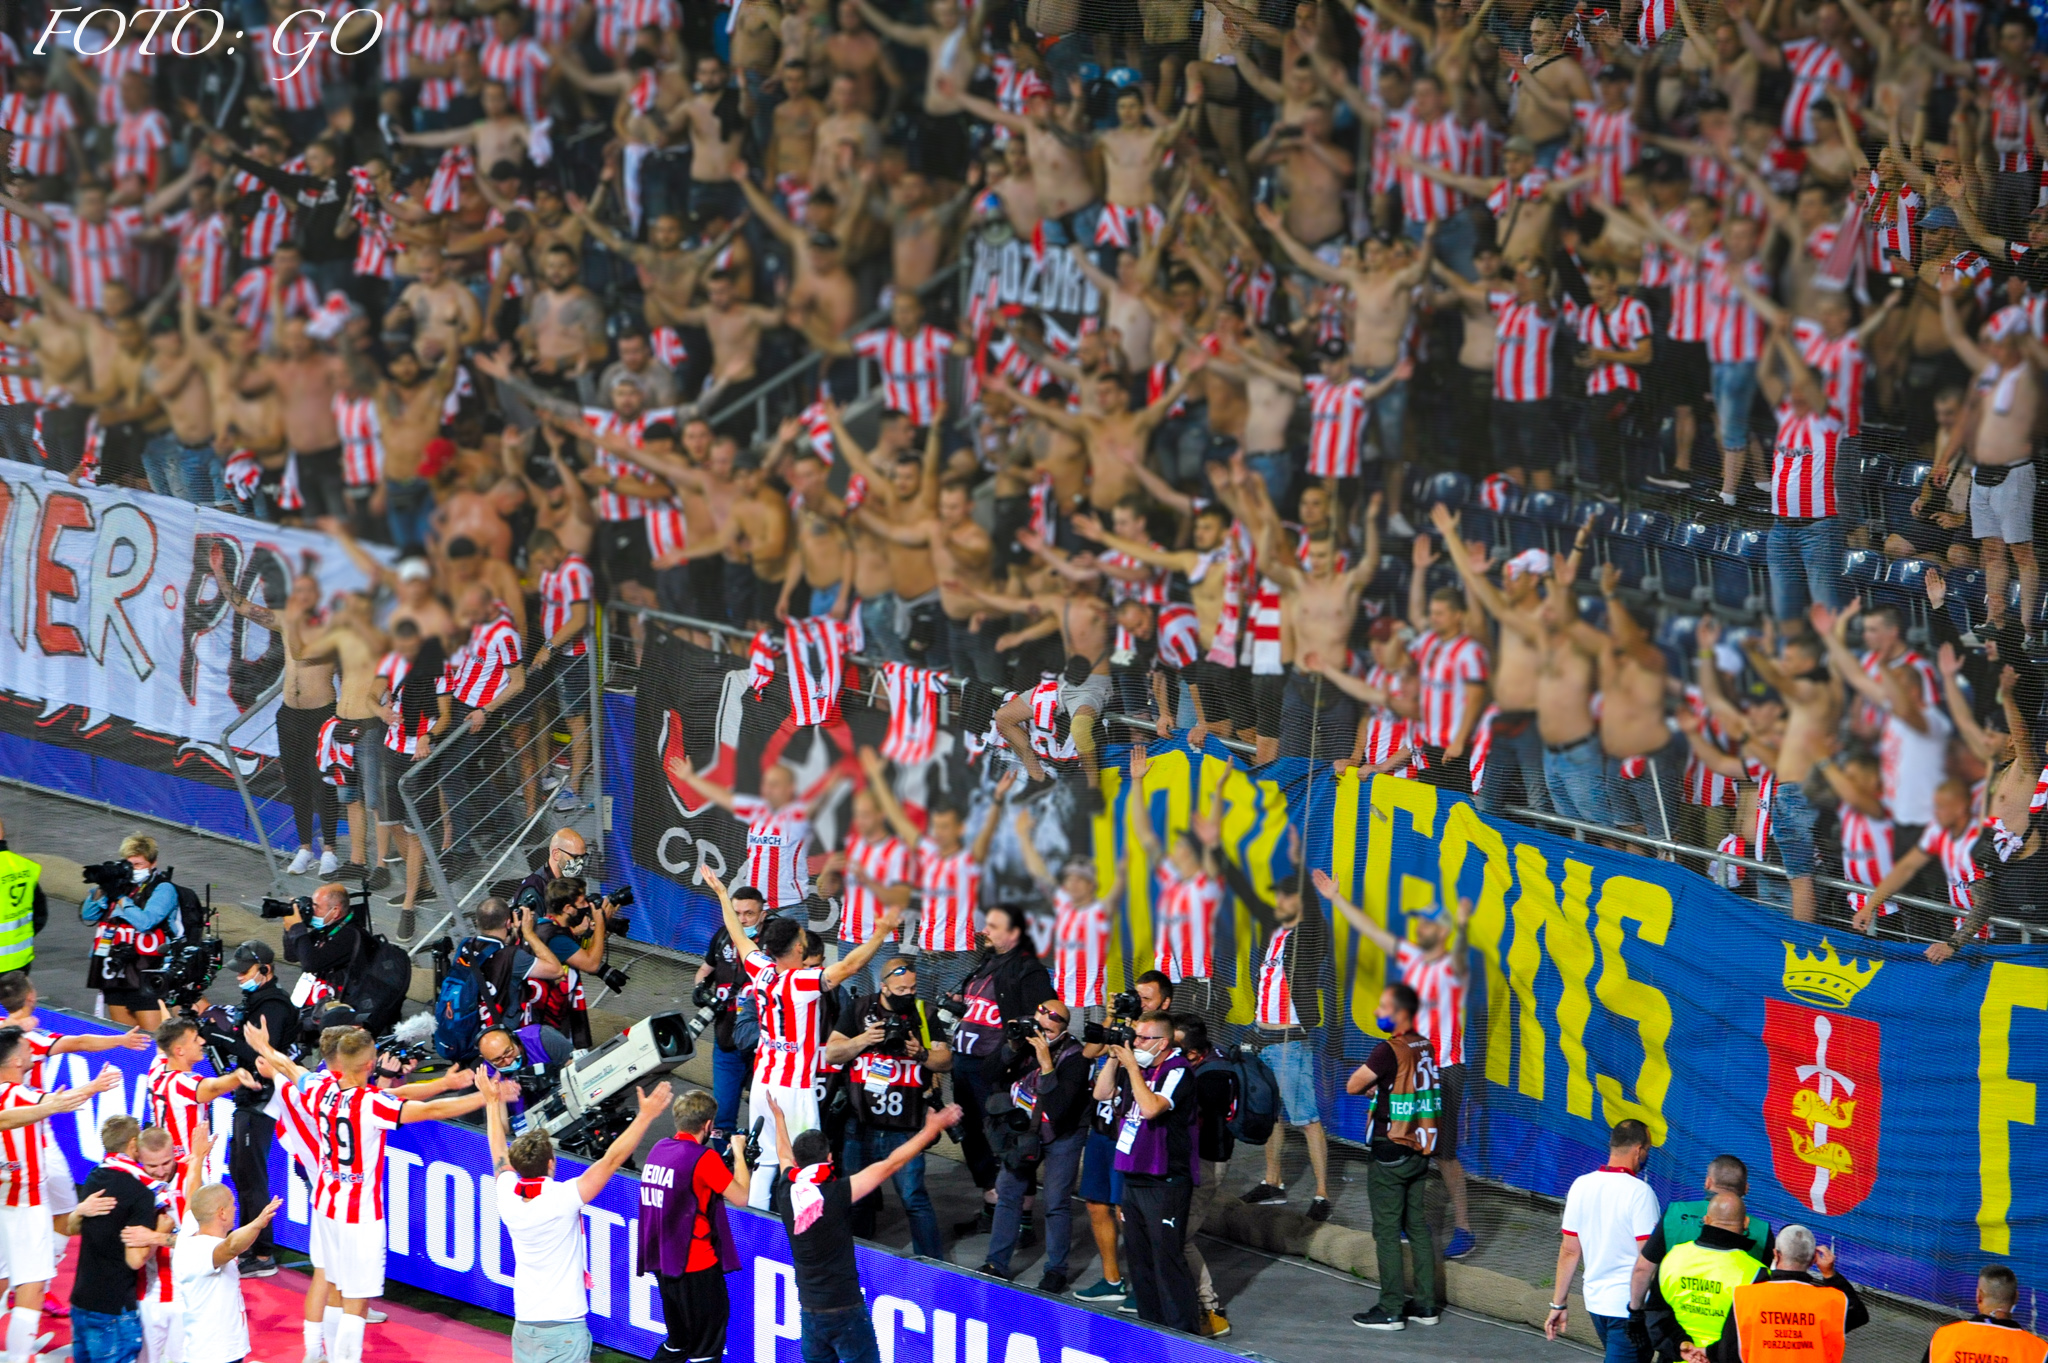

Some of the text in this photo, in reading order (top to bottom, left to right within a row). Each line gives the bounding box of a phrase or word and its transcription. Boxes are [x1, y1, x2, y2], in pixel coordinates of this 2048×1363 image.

[955, 1029, 980, 1055] 17
[870, 1091, 903, 1116] 38
[1680, 1276, 1722, 1294] STEWARD
[1760, 1311, 1816, 1326] STEWARD
